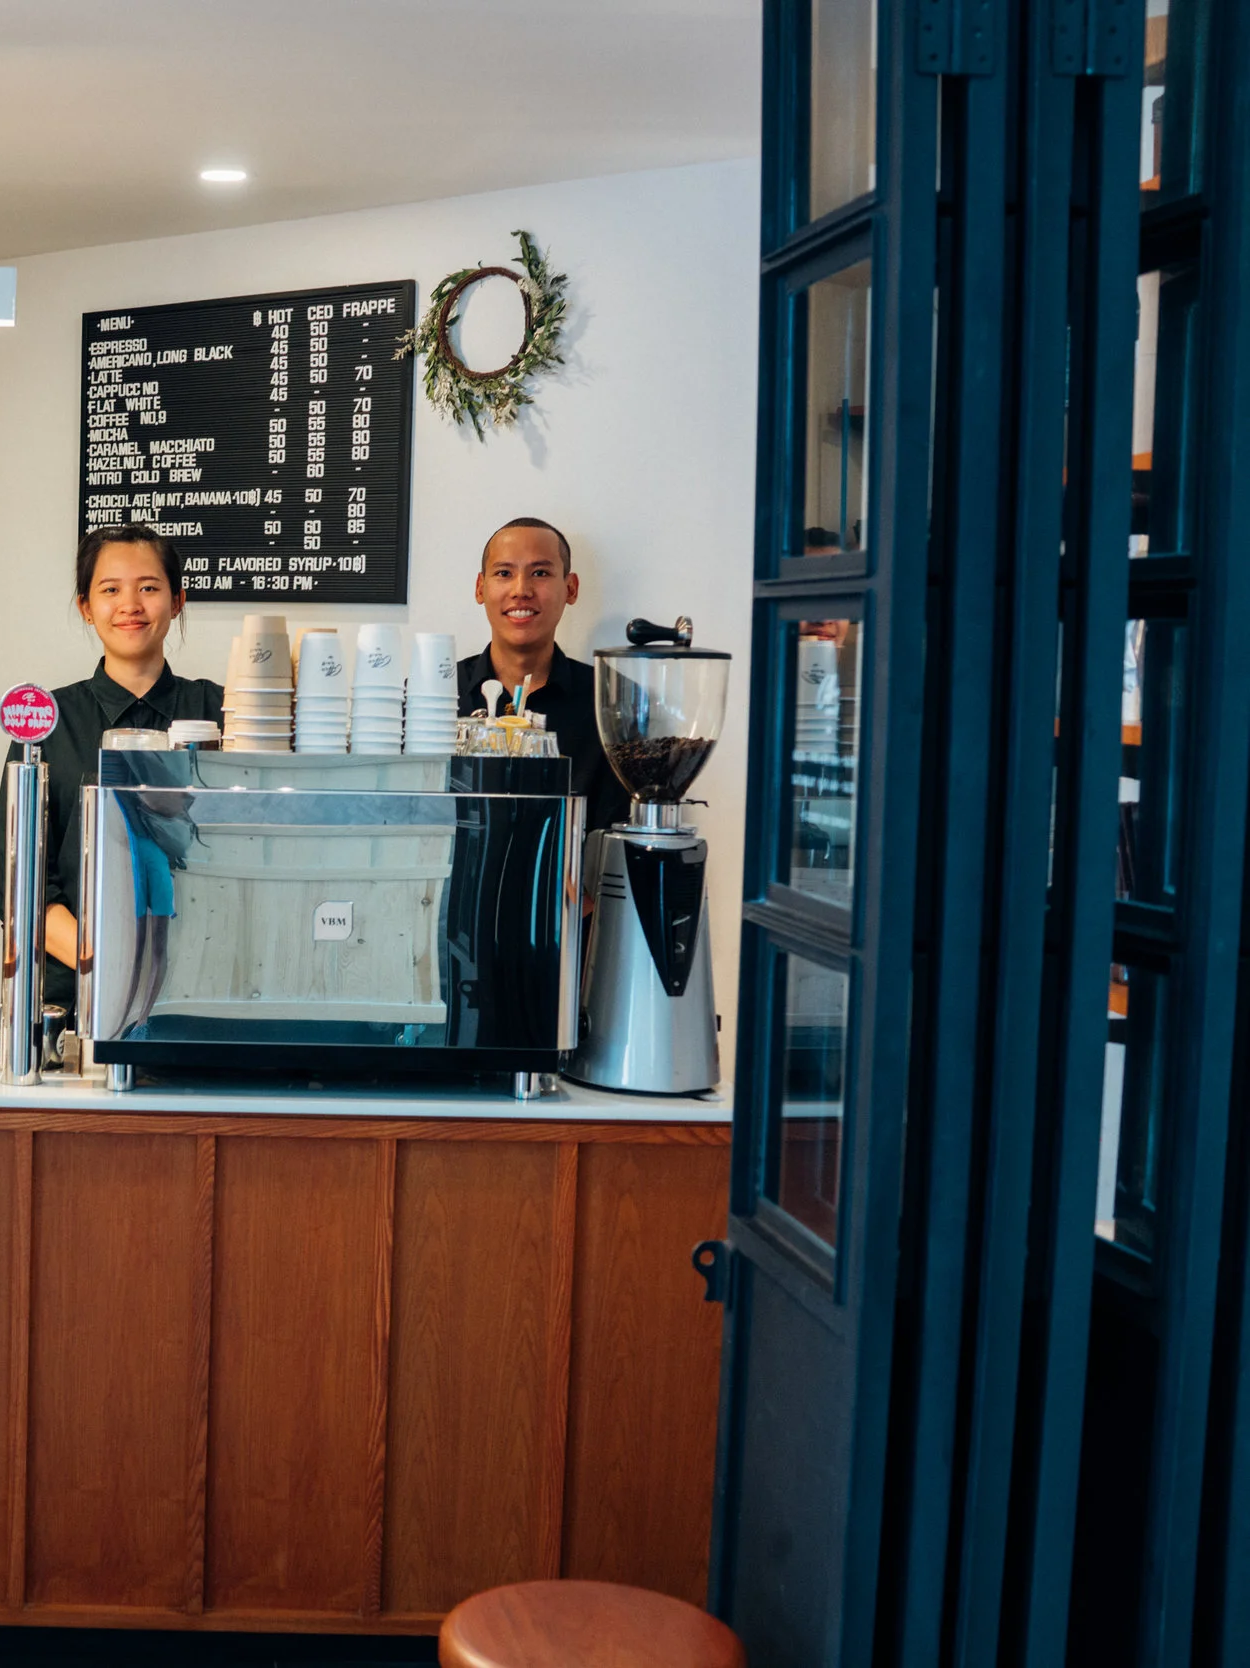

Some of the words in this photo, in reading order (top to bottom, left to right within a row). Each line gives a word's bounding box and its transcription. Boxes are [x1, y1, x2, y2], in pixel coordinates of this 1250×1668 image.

[268, 308, 294, 325] HOT
[342, 298, 395, 318] FRAPPE
[271, 325, 289, 339] 40
[310, 321, 328, 336] 50
[193, 345, 233, 361] BLACK
[270, 340, 288, 355] 45
[310, 337, 328, 352] 50
[270, 356, 288, 370] 45
[310, 353, 328, 367] 50
[270, 371, 288, 386] 45
[310, 369, 327, 384] 50
[354, 365, 373, 381] 70
[125, 396, 161, 411] WHITE
[270, 387, 288, 401] 45
[309, 400, 326, 414] 50
[353, 397, 372, 412] 70
[269, 418, 286, 433] 50
[308, 416, 326, 430] 55
[353, 414, 370, 428] 80
[150, 438, 215, 454] MACCHIATO
[269, 434, 285, 448] 50
[308, 432, 325, 446] 55
[352, 430, 370, 444] 80
[152, 453, 197, 468] COFFEE
[269, 449, 285, 463] 50
[307, 448, 325, 462] 55
[351, 445, 370, 460] 80
[131, 470, 160, 484] COLD
[170, 468, 202, 482] BREW
[307, 463, 324, 477] 60
[264, 489, 282, 504] 45
[304, 488, 322, 503] 50
[348, 487, 366, 502] 70
[131, 508, 161, 522] MALT
[347, 503, 366, 518] 80
[264, 520, 281, 535] 50
[304, 520, 321, 535] 60
[347, 519, 365, 534] 85
[303, 536, 320, 550] 50
[183, 558, 209, 571] ADD
[218, 557, 281, 571] FLAVORED
[213, 576, 232, 589] AM
[251, 575, 289, 590] 16:30
[321, 917, 346, 926] VBM
